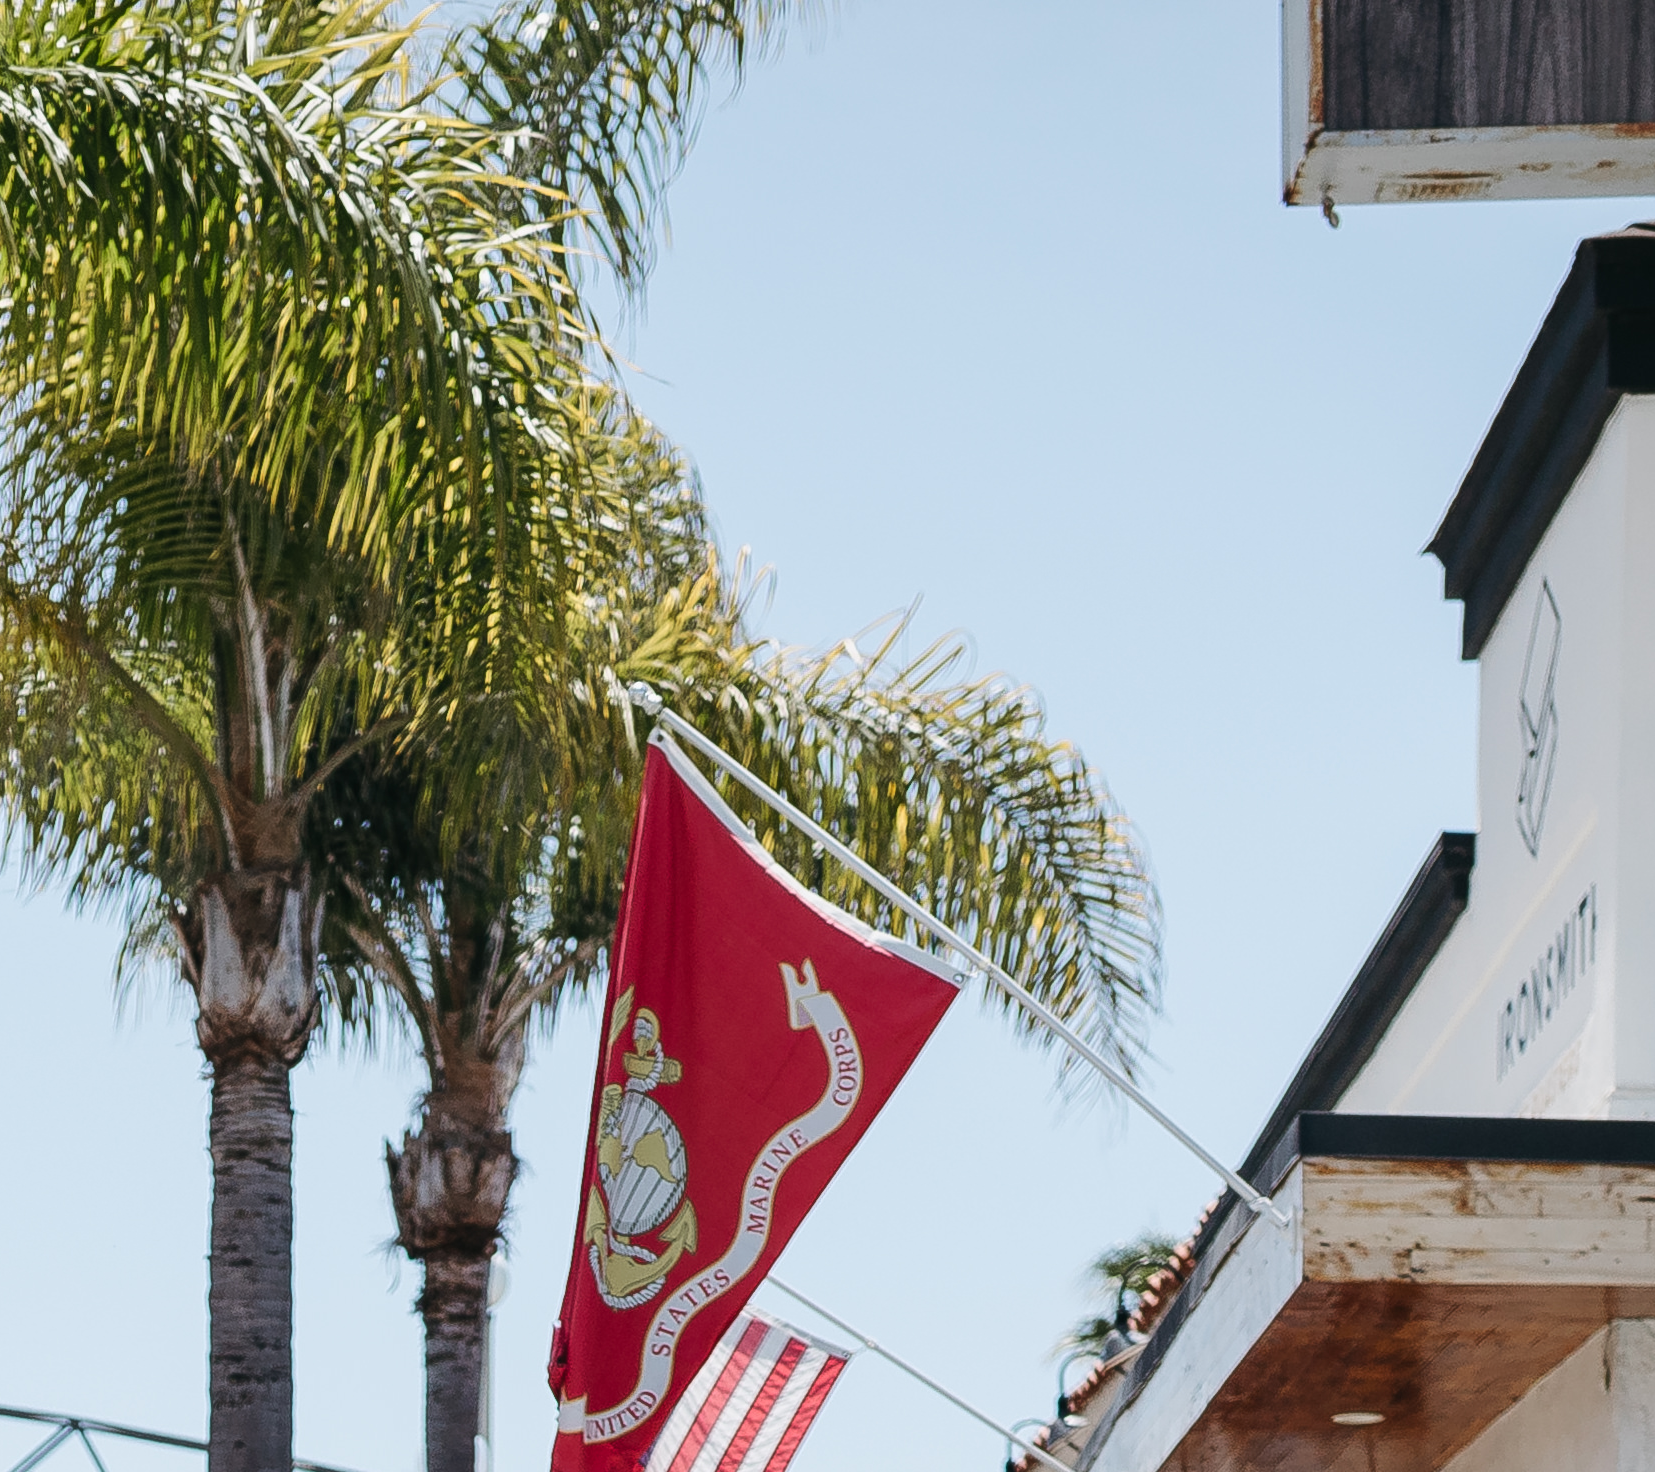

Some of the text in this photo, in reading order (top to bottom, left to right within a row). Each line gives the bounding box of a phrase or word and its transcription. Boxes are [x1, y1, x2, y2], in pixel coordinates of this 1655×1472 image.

[652, 1269, 730, 1357] STATES
[747, 1129, 808, 1235] MARINE
[829, 1027, 858, 1107] CORPS
